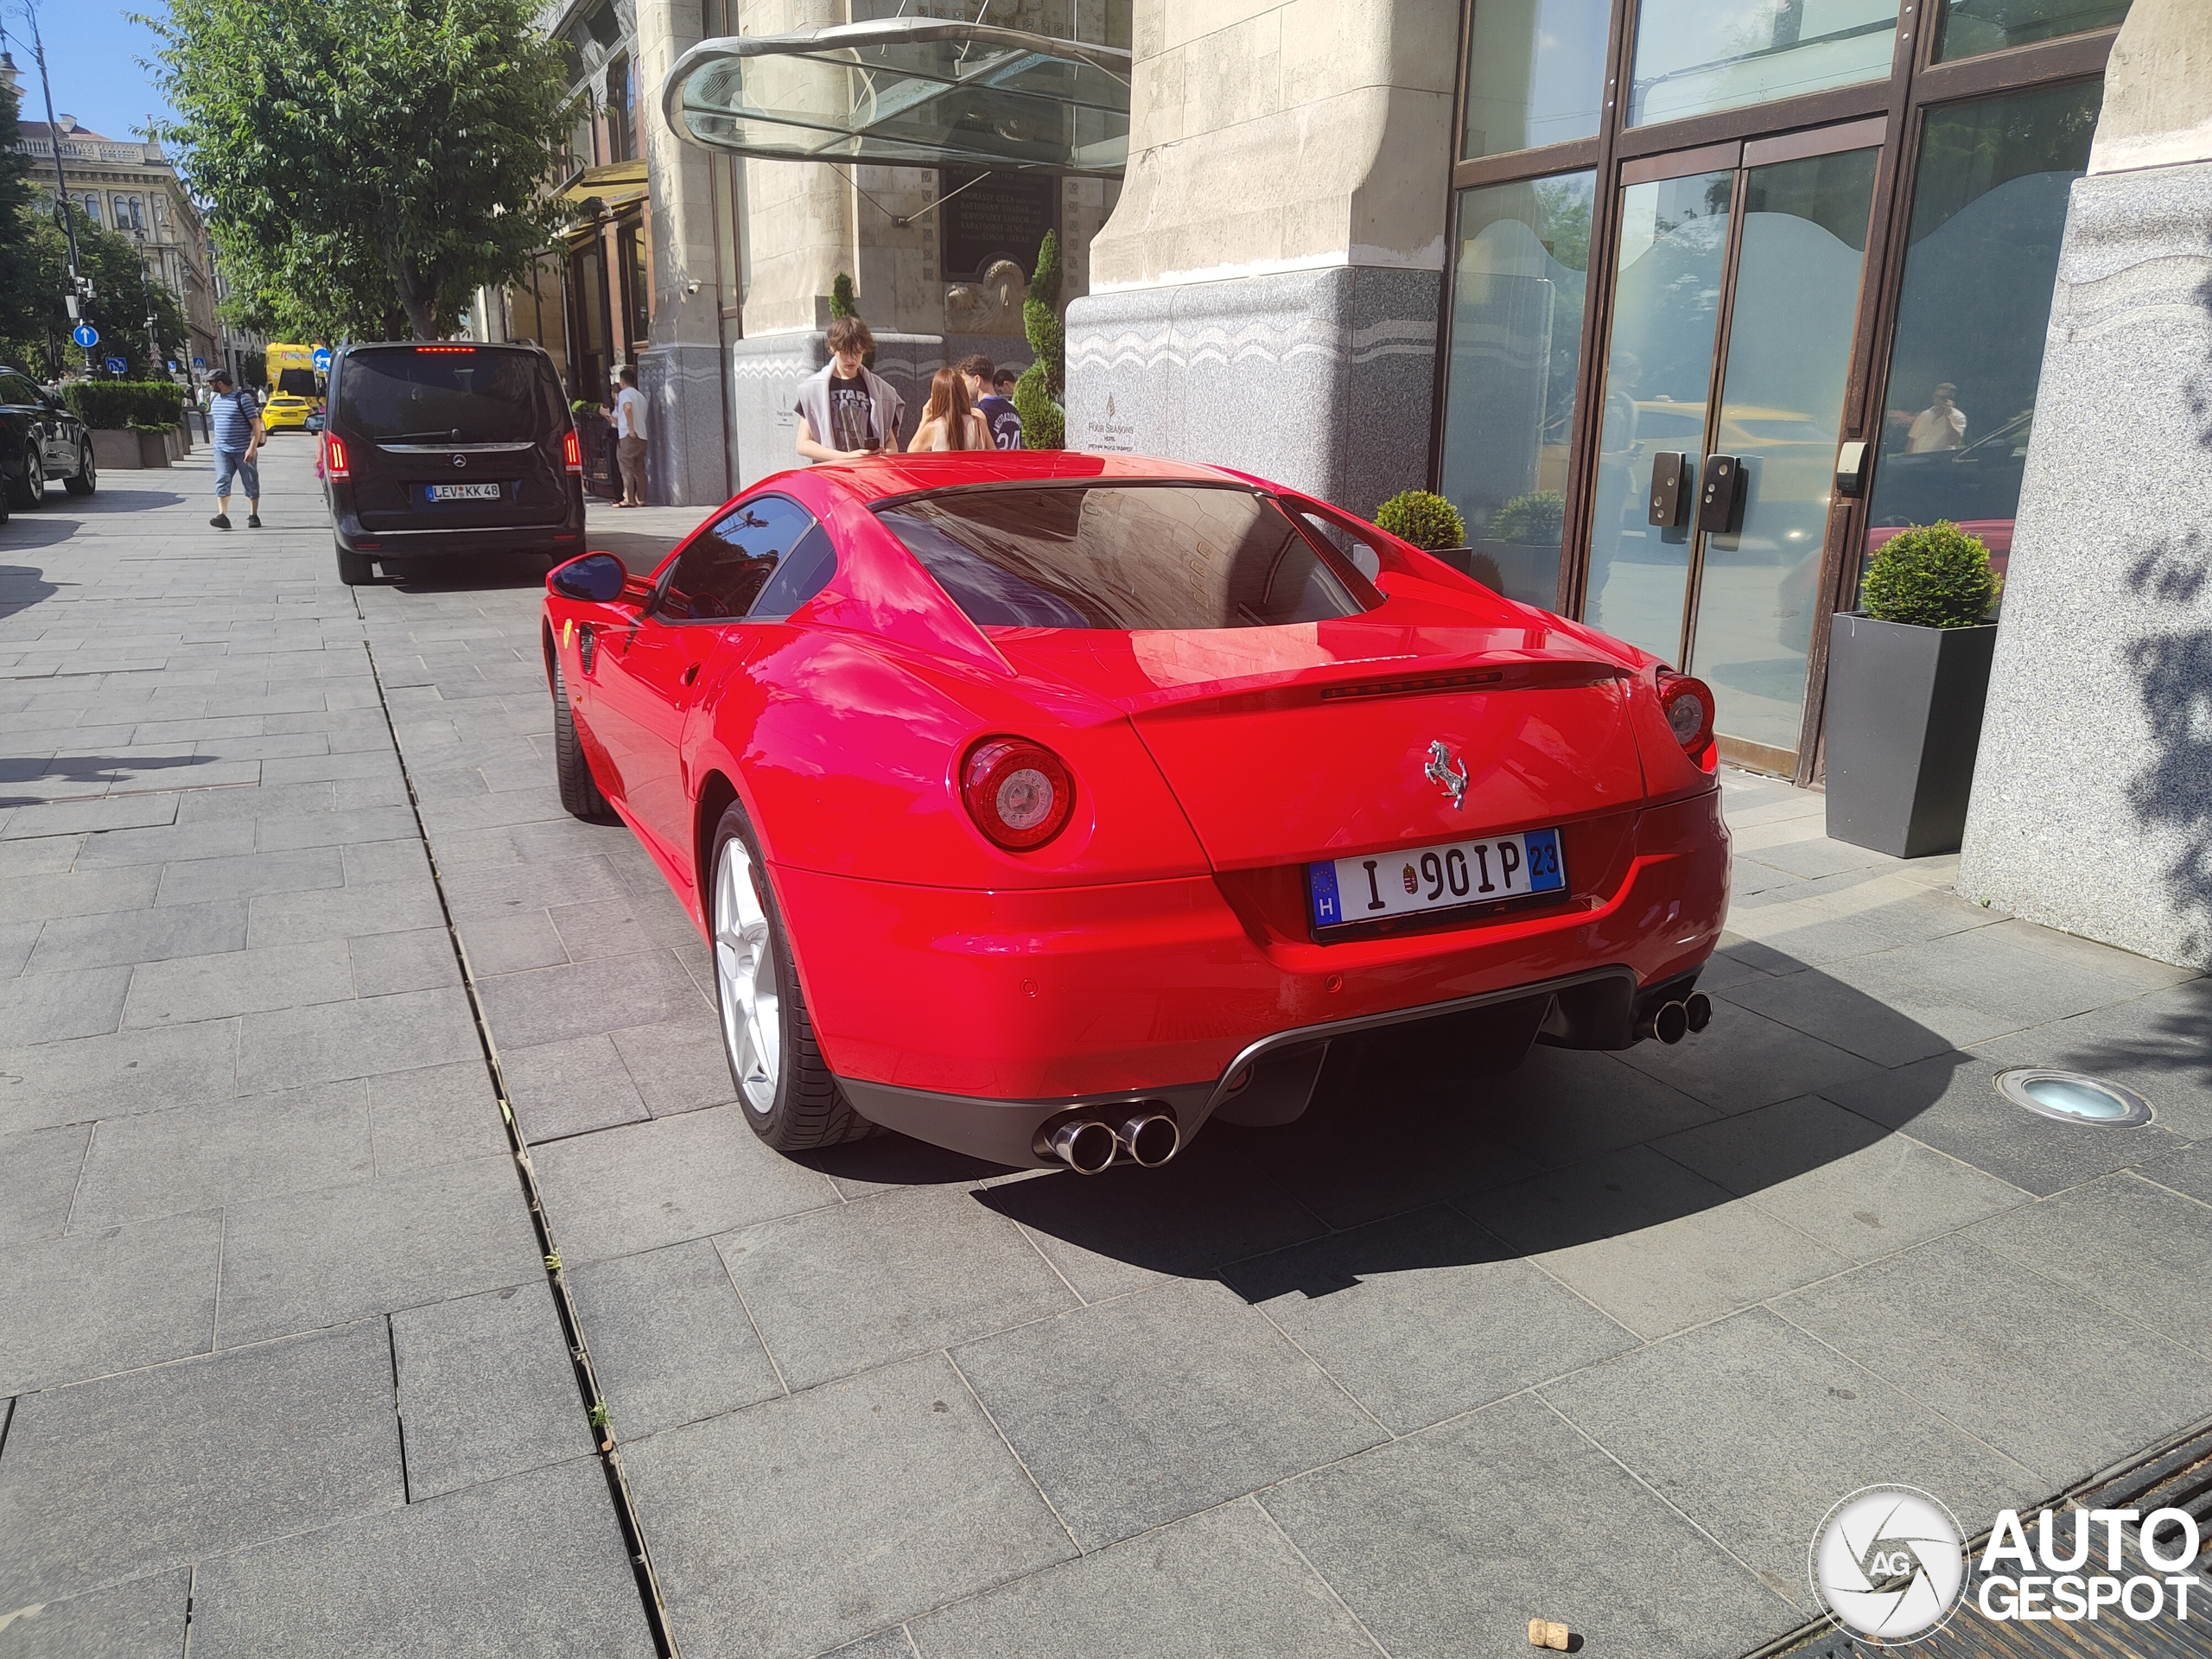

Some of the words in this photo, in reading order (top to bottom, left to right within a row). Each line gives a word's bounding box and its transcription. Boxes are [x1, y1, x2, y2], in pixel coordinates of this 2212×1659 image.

[830, 389, 869, 403] STAR
[830, 399, 870, 410] ARS
[434, 486, 457, 498] LEV
[466, 486, 481, 496] KK
[485, 486, 499, 495] 48
[1529, 843, 1558, 876] 23
[1319, 898, 1333, 916] H
